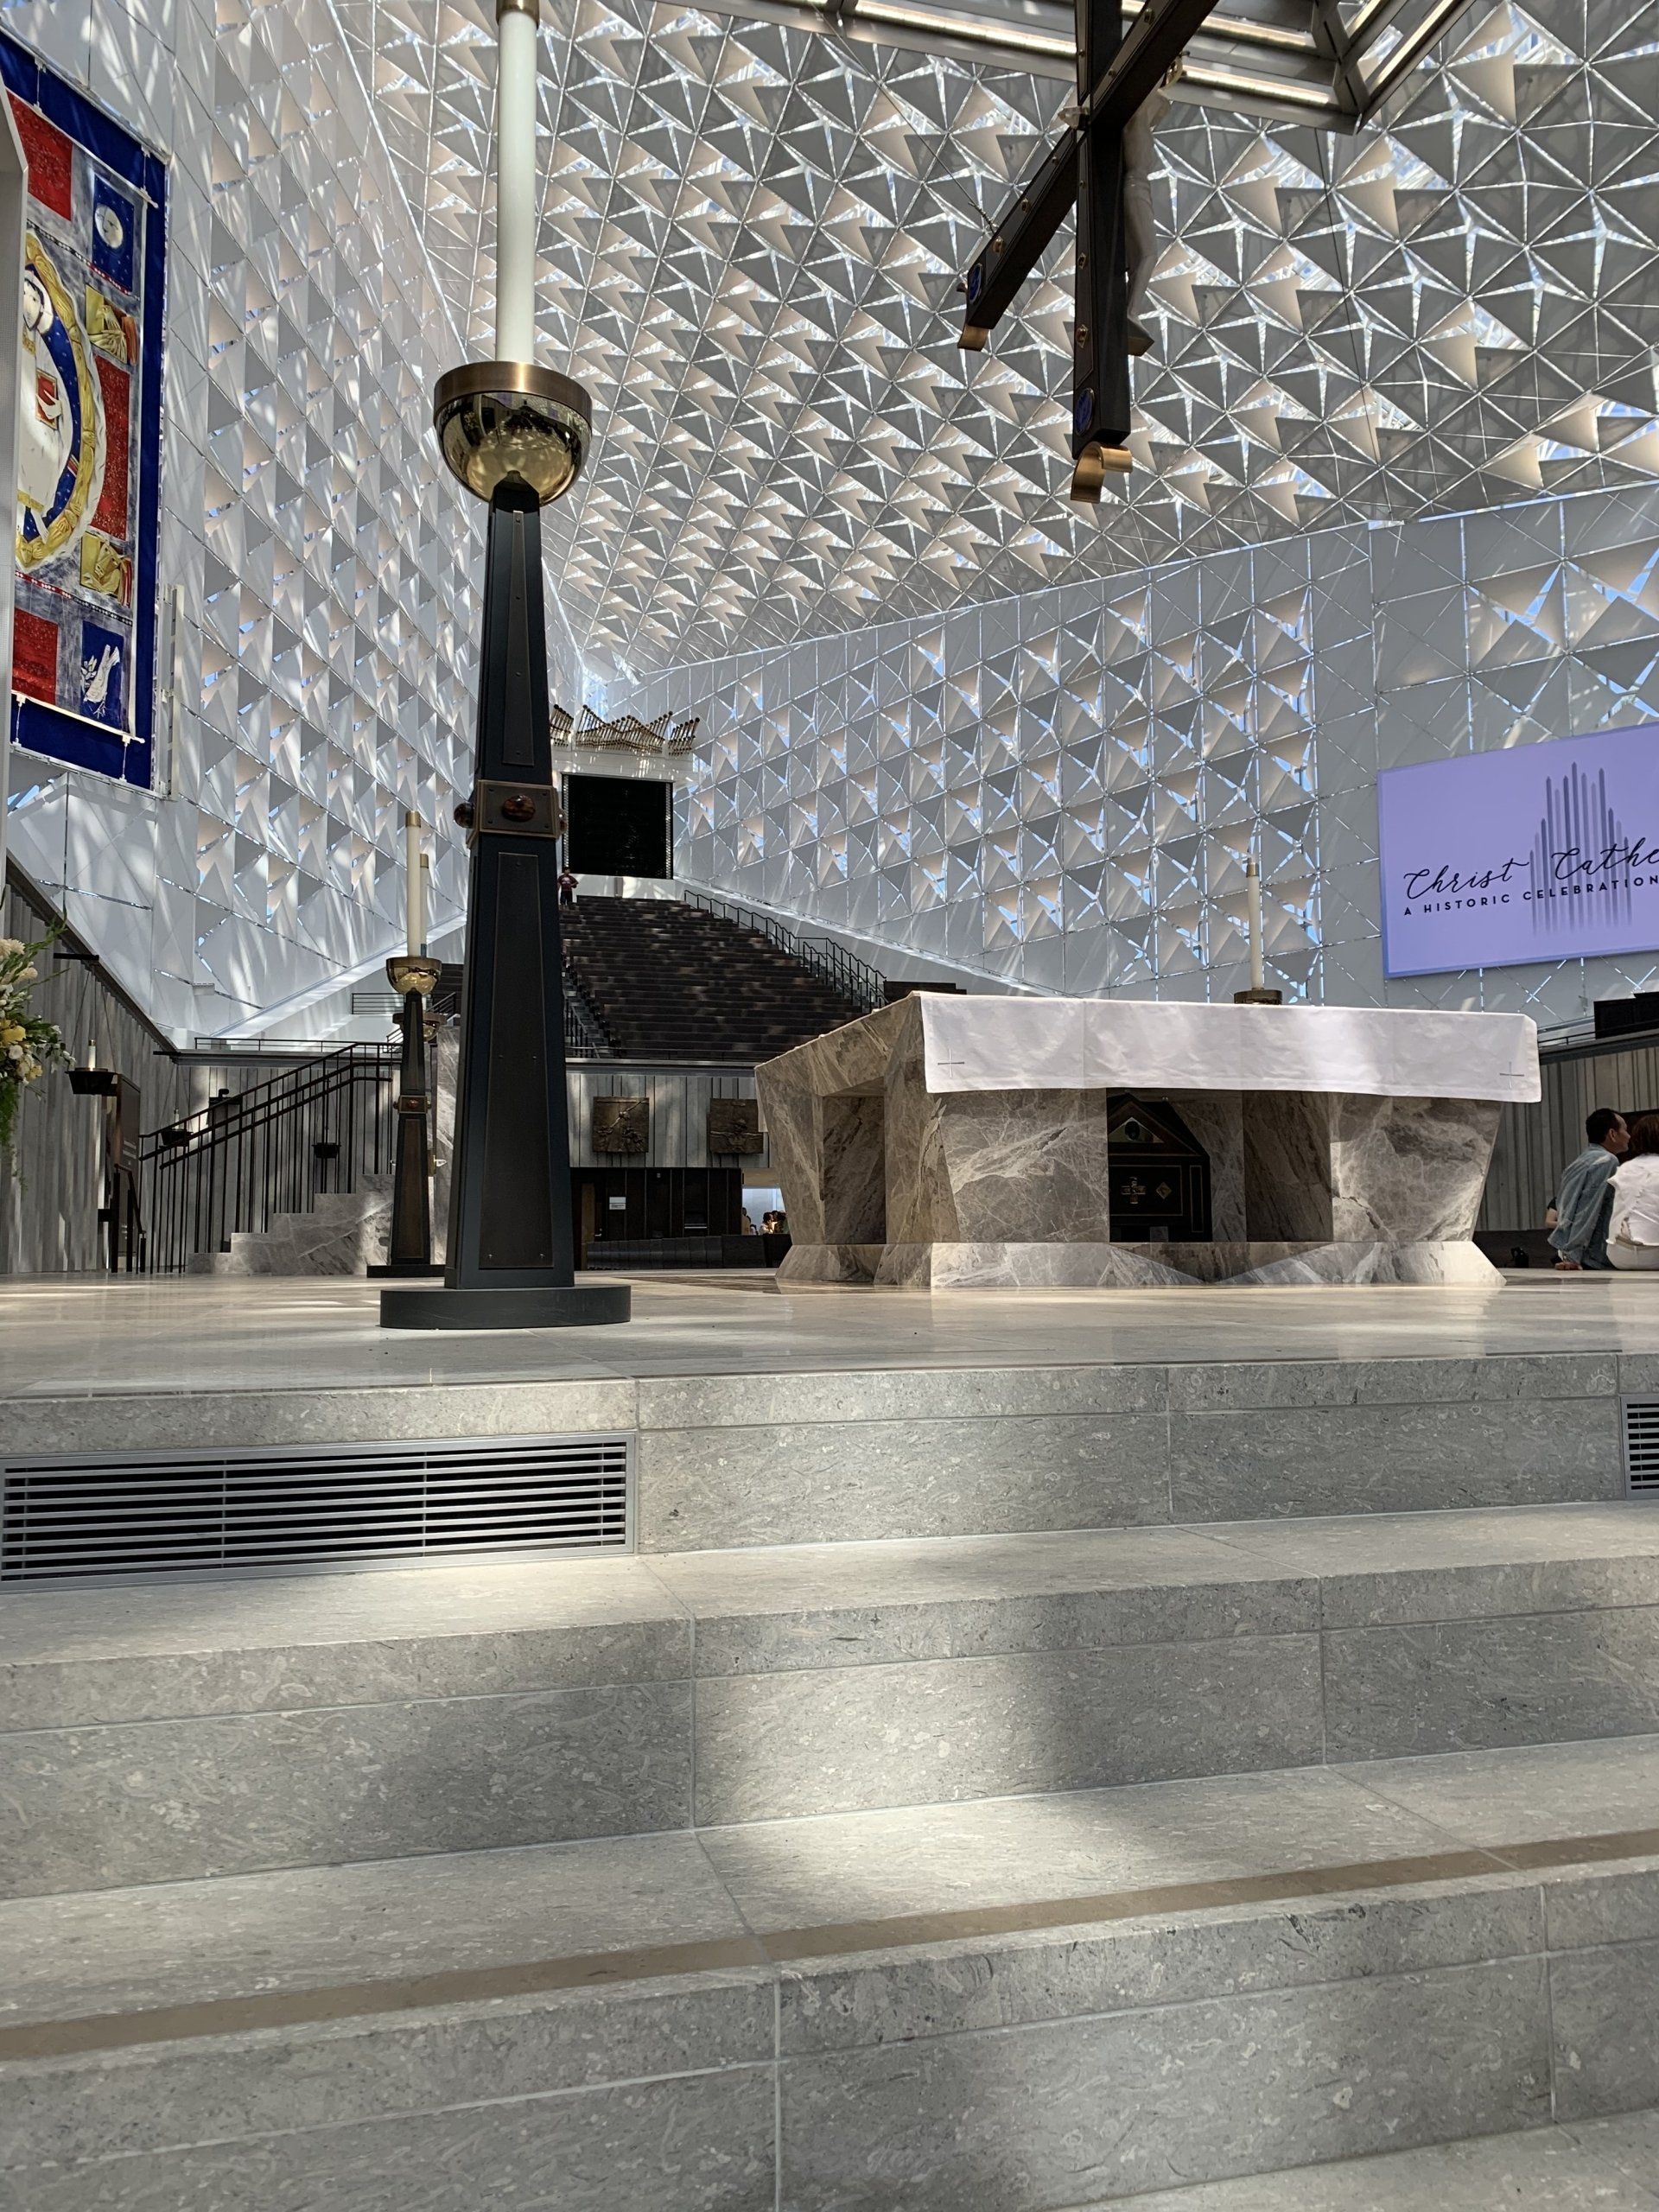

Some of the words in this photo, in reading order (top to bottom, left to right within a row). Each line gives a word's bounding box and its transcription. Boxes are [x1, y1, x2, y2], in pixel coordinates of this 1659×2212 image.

[1403, 857, 1529, 899] Christ
[1404, 906, 1412, 916] A
[1424, 893, 1510, 913] HISTORIC
[1522, 874, 1659, 900] CELEBRATION
